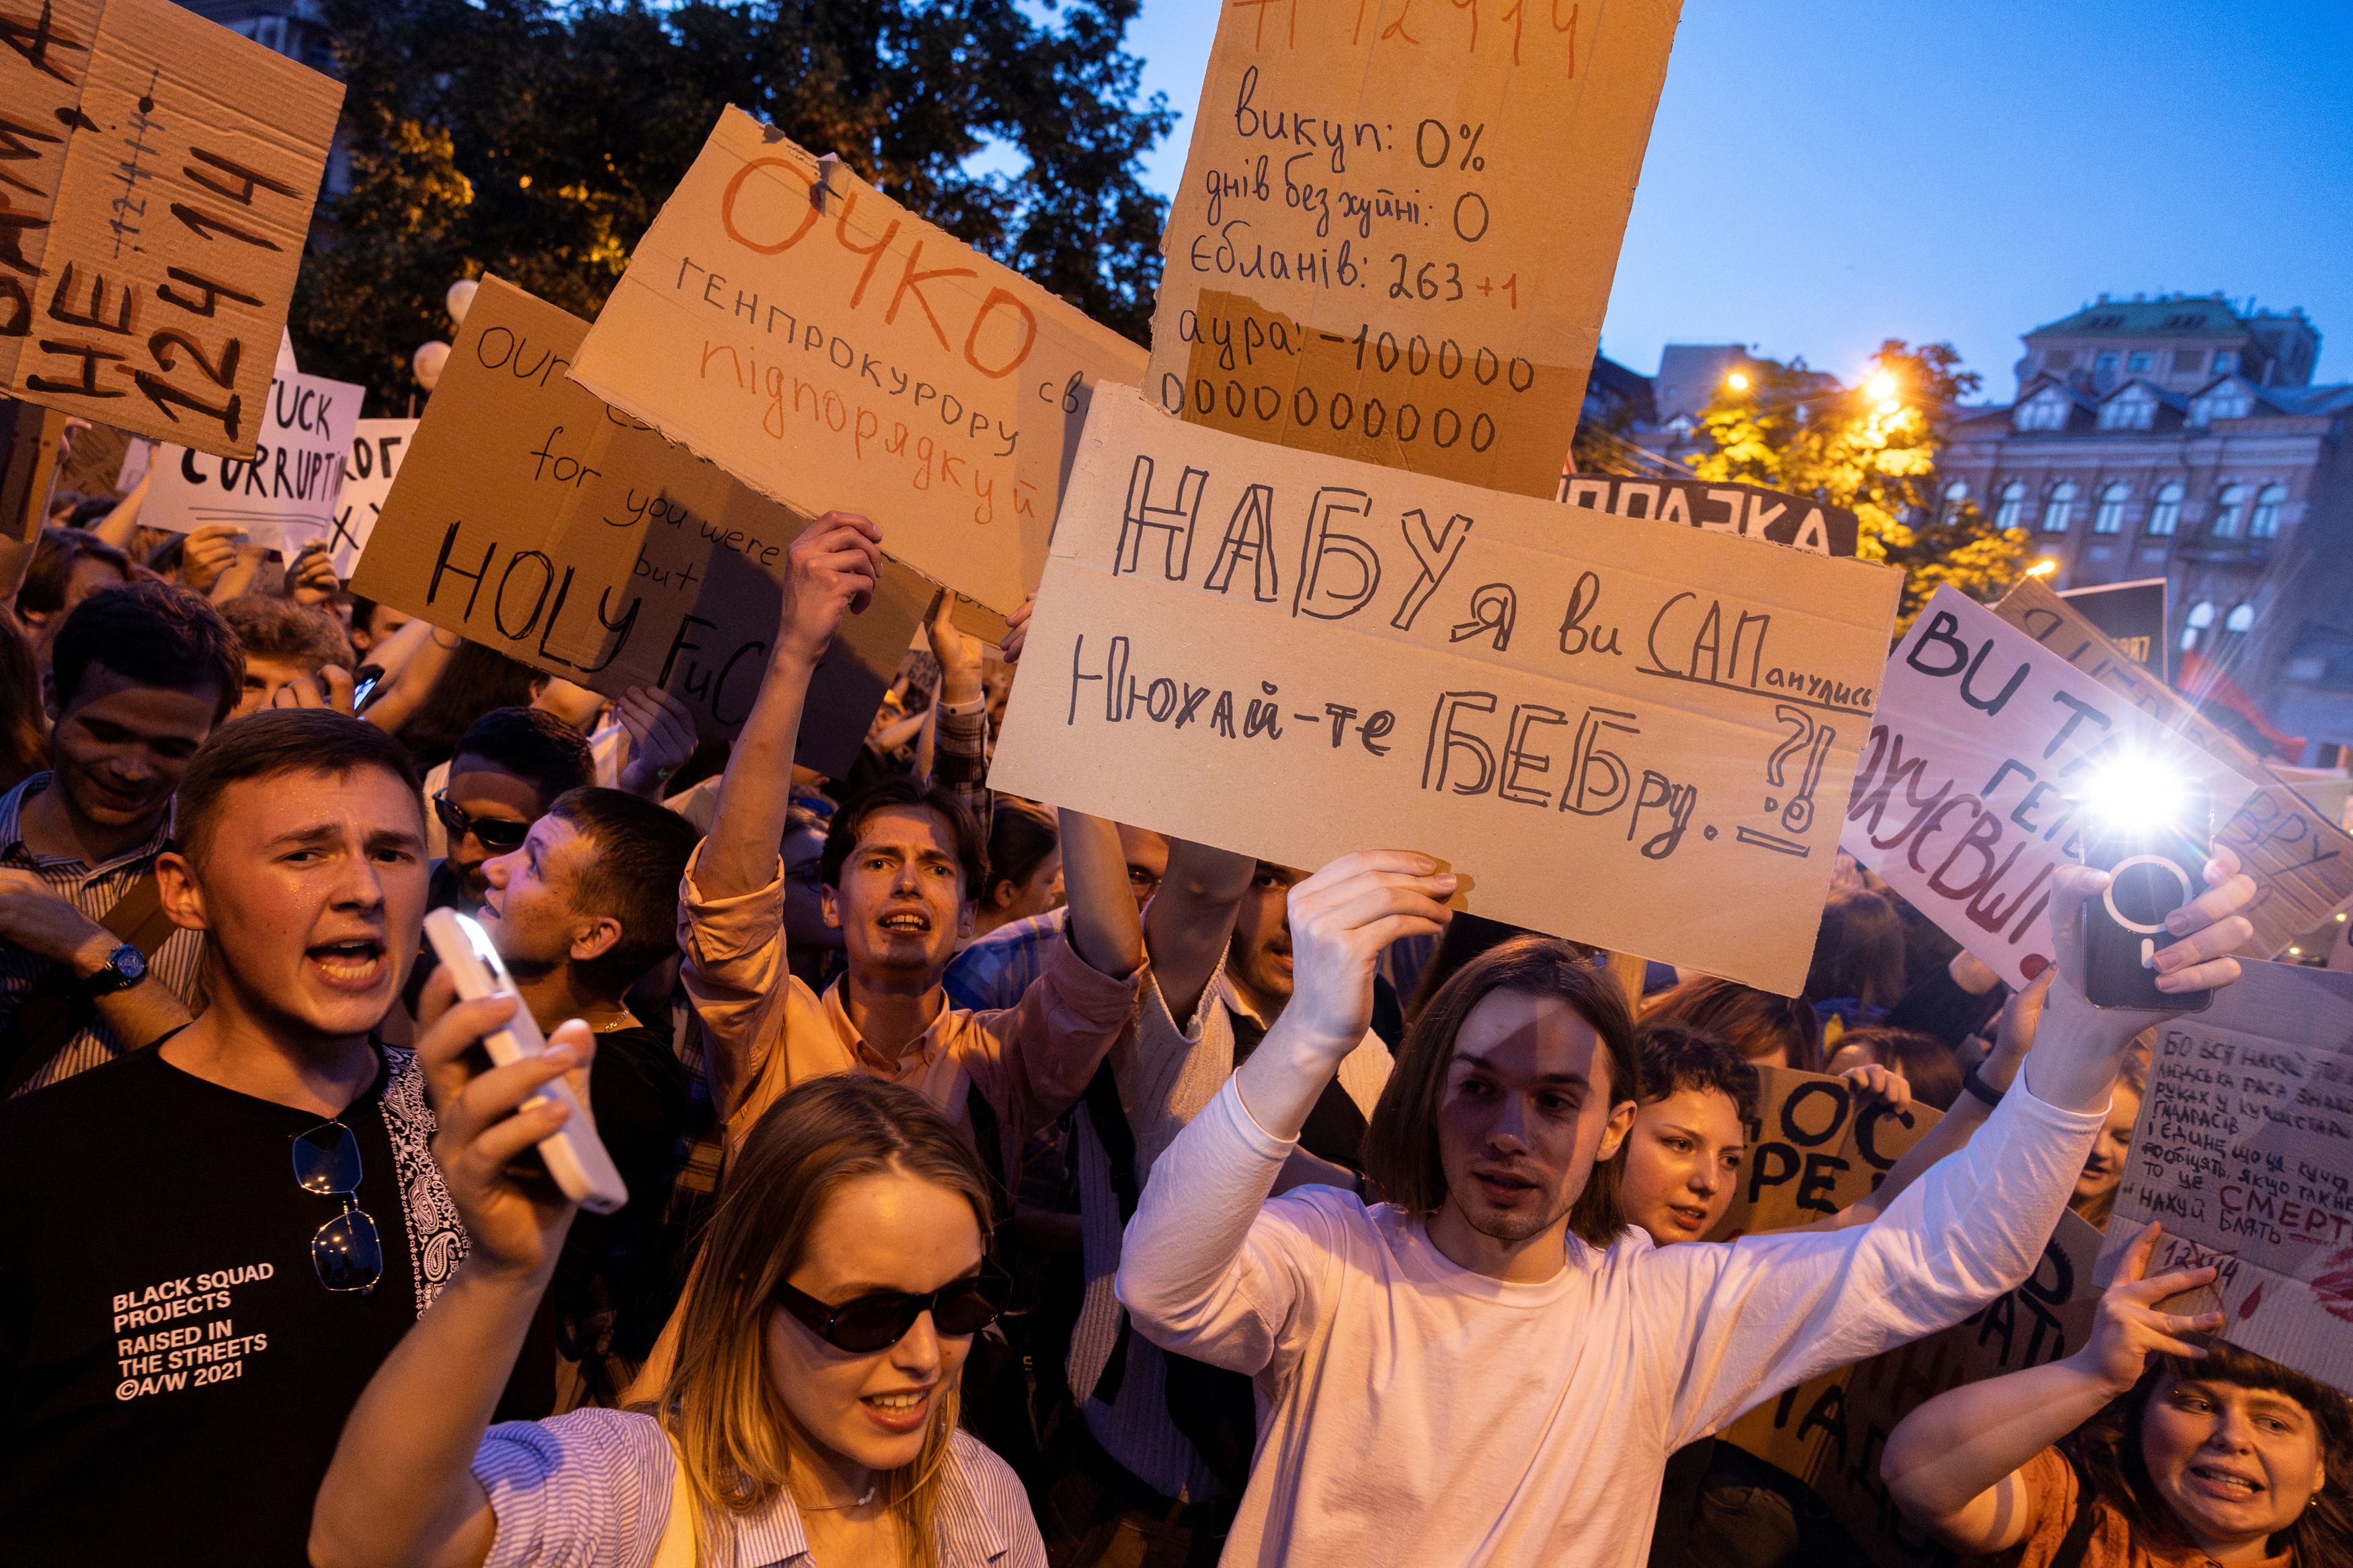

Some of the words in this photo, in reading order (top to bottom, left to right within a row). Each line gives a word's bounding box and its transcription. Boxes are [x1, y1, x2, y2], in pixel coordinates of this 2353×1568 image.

[1235, 65, 1393, 173] викуп:
[1416, 119, 1486, 172] 0%
[1206, 155, 1270, 225] днів
[1284, 153, 1328, 237] без
[1453, 192, 1489, 242] 0
[721, 157, 1037, 379] ОЧКО
[1389, 253, 1463, 300] 263
[1478, 273, 1517, 309] +1
[26, 261, 134, 398] НЕ
[677, 256, 1019, 456] ГЕНПРОКУРОРУ
[1038, 370, 1089, 414] св
[270, 378, 333, 442] UCK
[700, 339, 1037, 526] підпорядкуй
[344, 437, 402, 482] ОГ
[530, 427, 602, 489] for
[602, 487, 688, 527] you
[699, 524, 781, 567] were
[1556, 477, 1830, 559] АЗКА
[633, 544, 700, 592] but
[1559, 571, 1622, 654] ви
[1906, 610, 2031, 717] ВИ
[1747, 1081, 1915, 1170] ОС
[1748, 1142, 1887, 1215] РЕ
[2143, 1161, 2164, 1178] ТО
[2220, 1185, 2353, 1242] СМЕРТ
[113, 1277, 192, 1313] BLACK
[197, 1262, 274, 1292] SQUAD
[114, 1290, 231, 1333] PROJECTS
[118, 1326, 202, 1357] RAISED
[208, 1319, 233, 1340] IN
[118, 1354, 163, 1378] THE
[168, 1333, 268, 1369] STREETS
[116, 1371, 188, 1401] ©A/W
[194, 1360, 243, 1387] 2021
